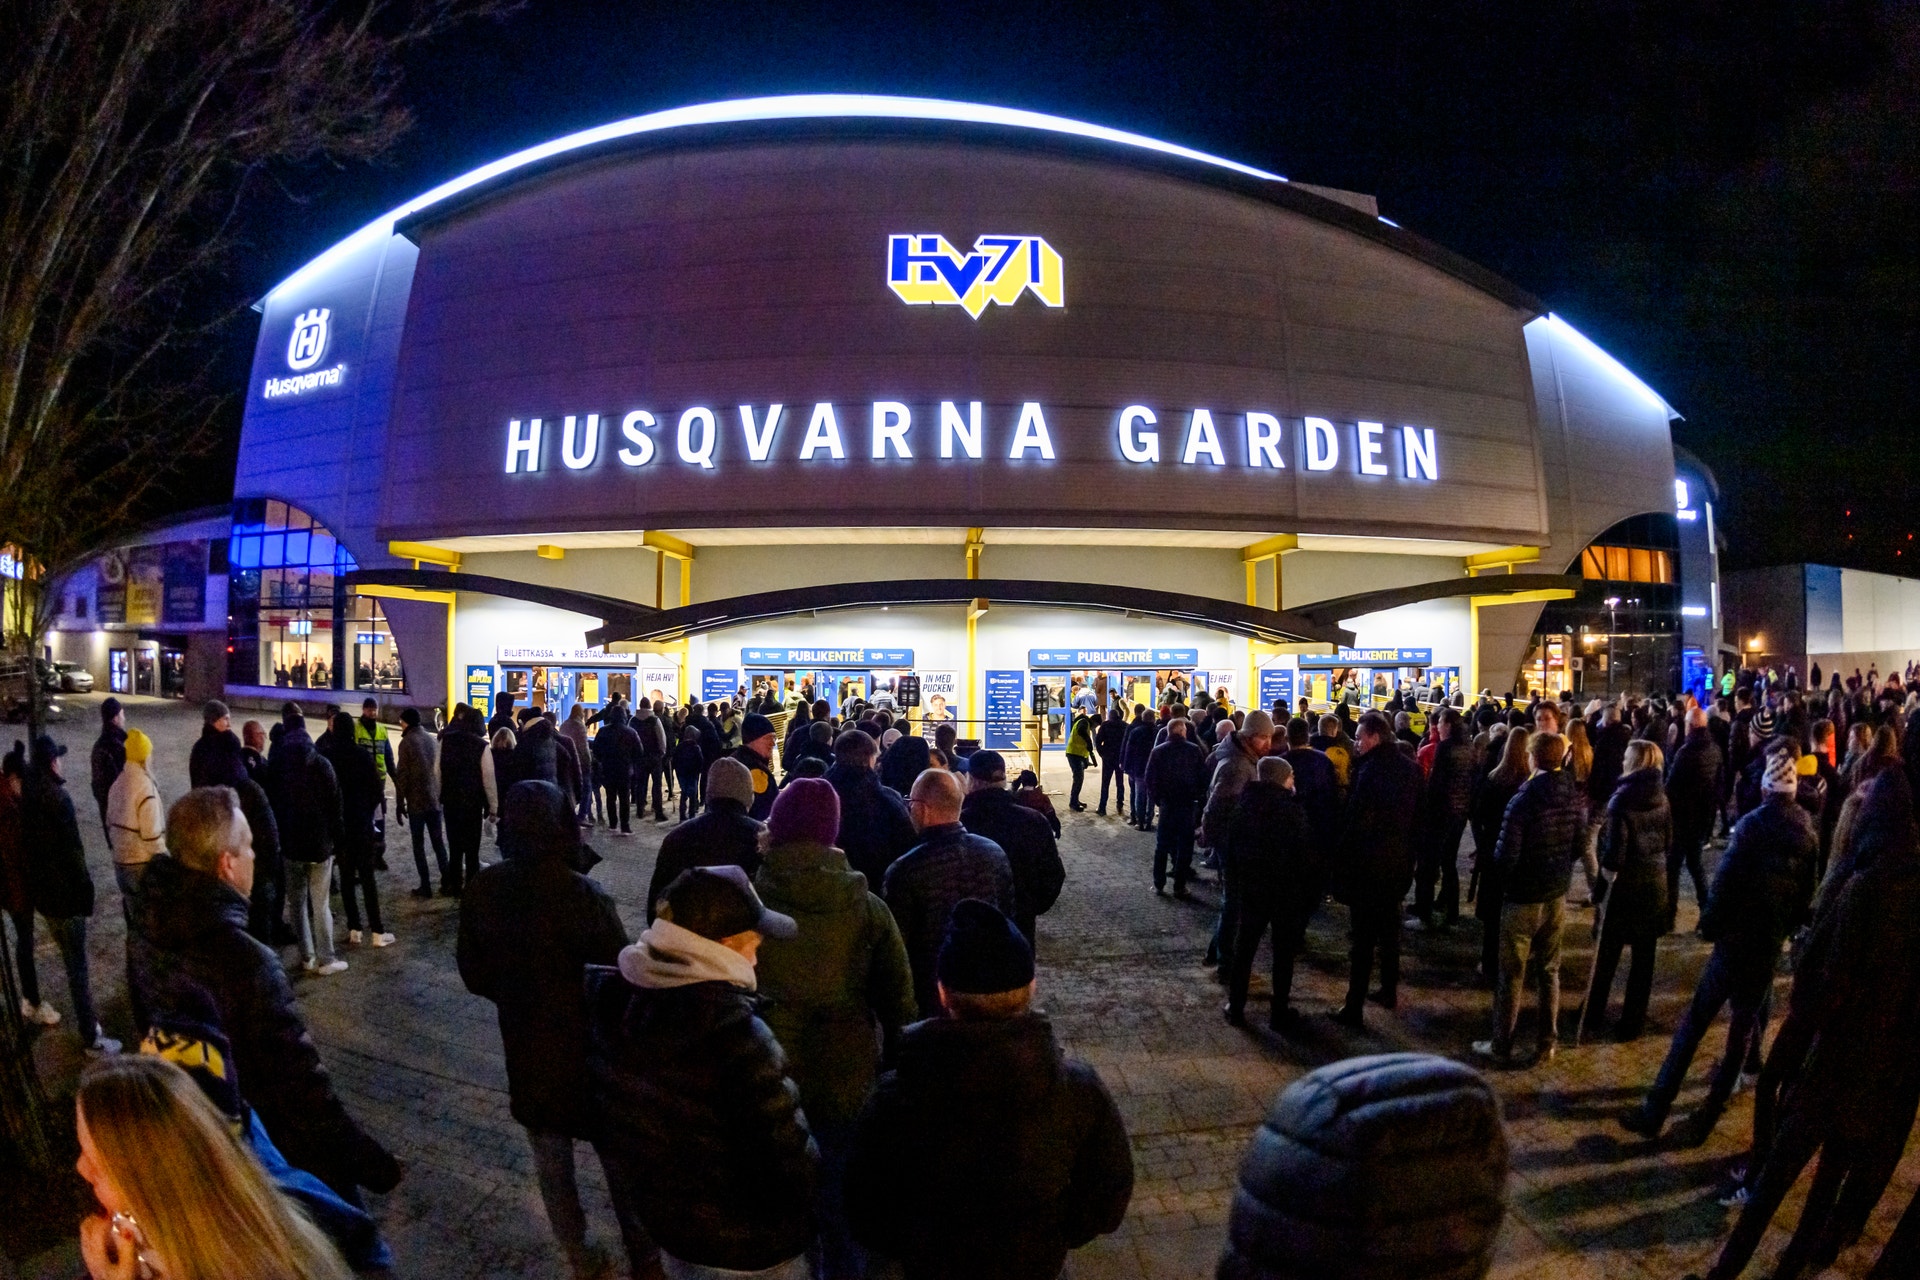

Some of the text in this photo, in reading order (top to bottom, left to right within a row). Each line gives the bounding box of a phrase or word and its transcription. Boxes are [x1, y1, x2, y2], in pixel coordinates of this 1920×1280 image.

[887, 234, 1065, 320] HV71
[264, 368, 341, 399] Husqvarna
[504, 400, 1438, 480] HUSQVARNA GARDEN
[504, 649, 554, 658] BILJETTKASSA
[788, 648, 864, 662] PUBLIKENTRÉ
[1077, 649, 1153, 663] PUBLIKENTRÉ
[1339, 648, 1399, 661] PUBLIKENTRÉ
[646, 673, 675, 682] HEJA HV!
[925, 674, 952, 683] IN MED
[922, 684, 955, 693] PUCKEN!
